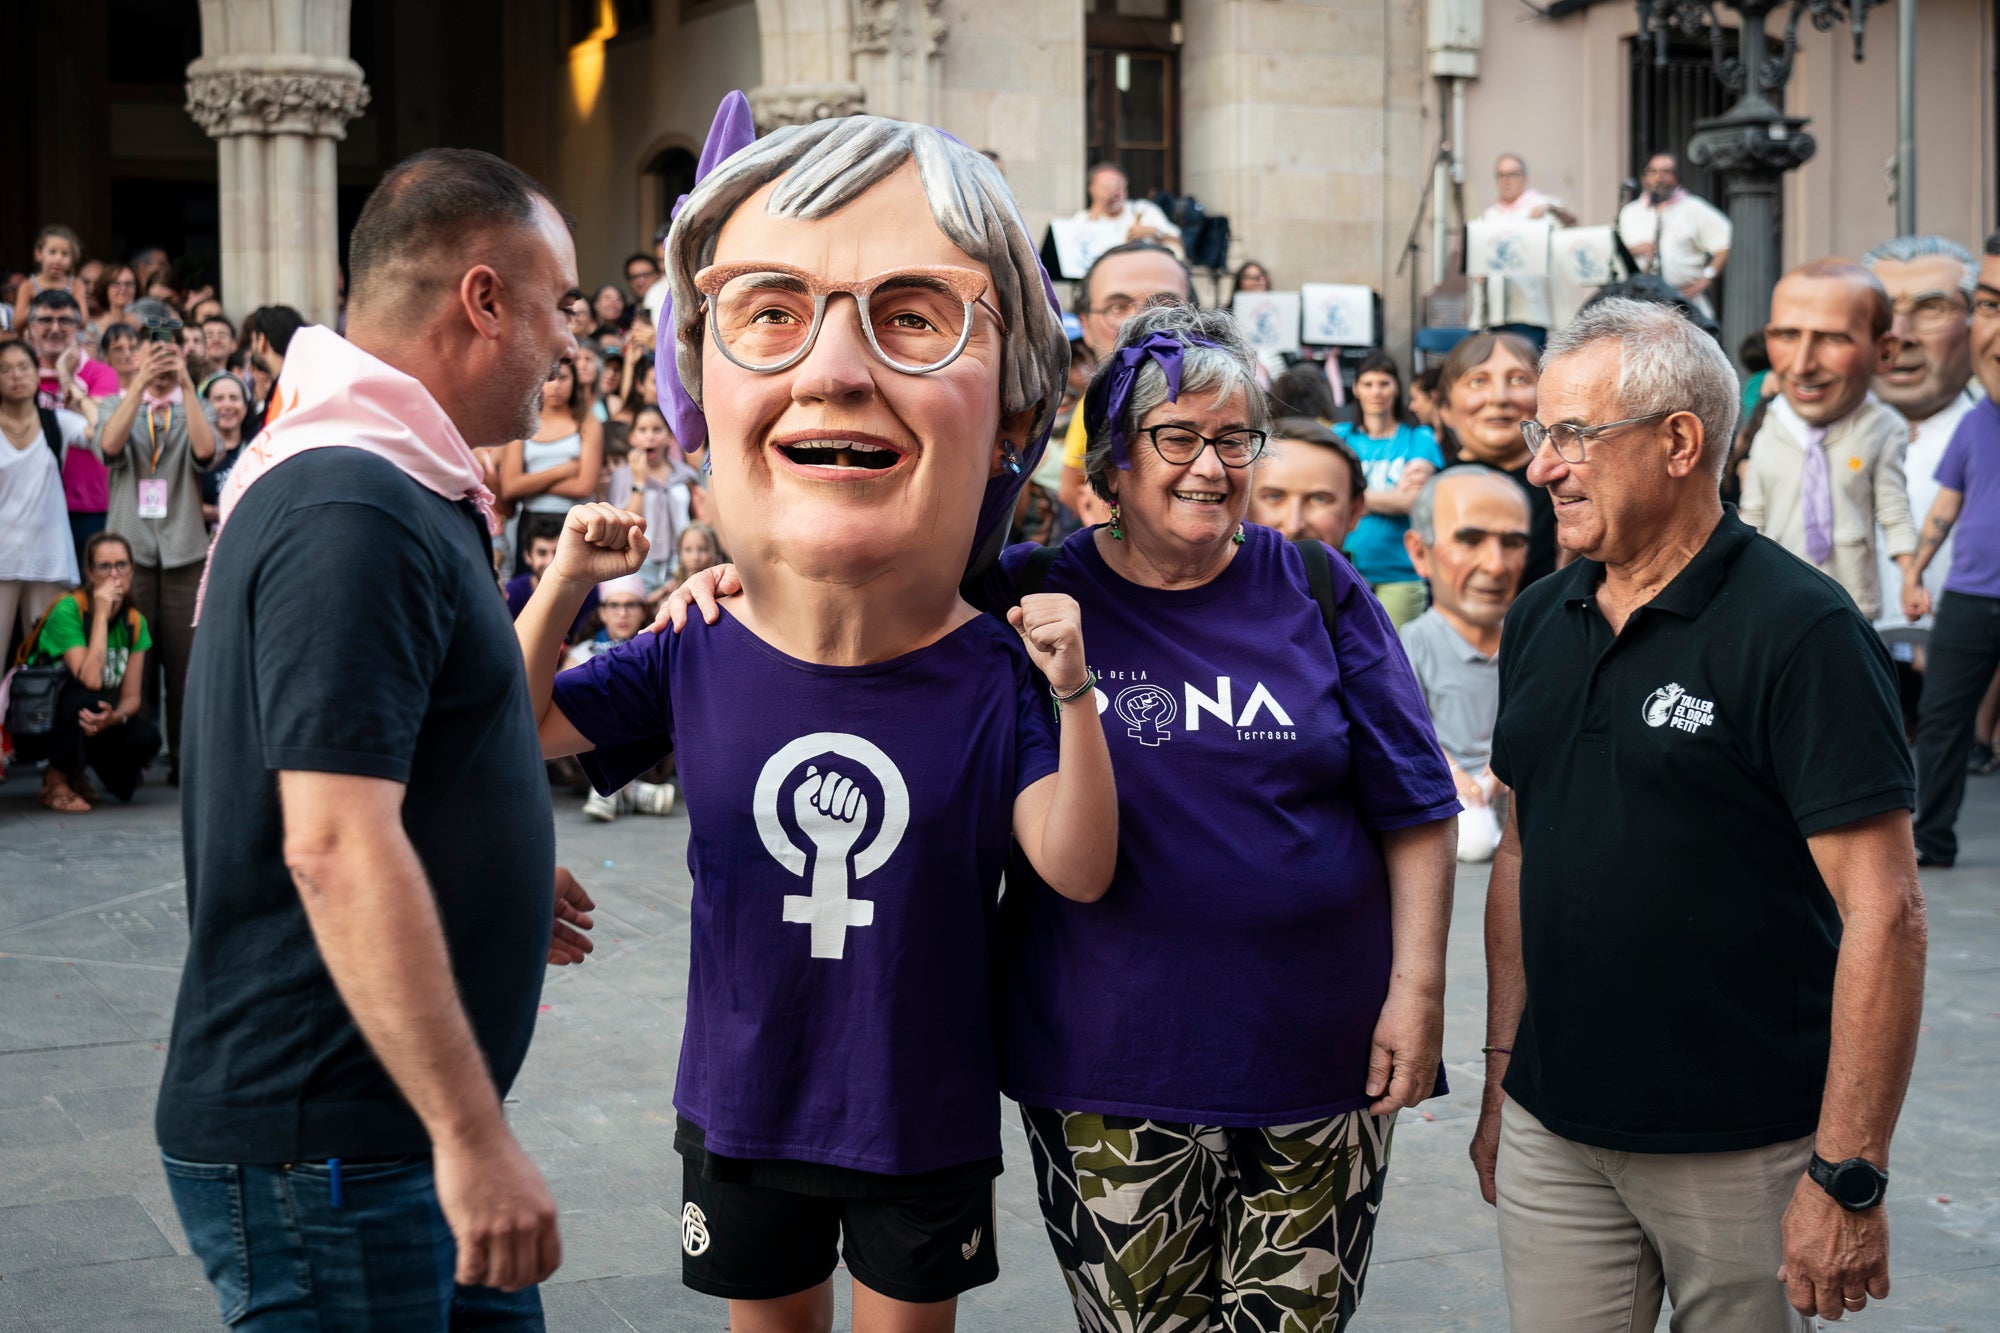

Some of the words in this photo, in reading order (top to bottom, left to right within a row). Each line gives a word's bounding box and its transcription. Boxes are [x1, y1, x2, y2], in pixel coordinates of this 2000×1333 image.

[1110, 670, 1125, 680] DE
[1131, 670, 1147, 681] LA
[1681, 694, 1714, 714] TALLER
[1674, 705, 1686, 718] EL
[1670, 716, 1700, 734] PETIT
[1237, 729, 1297, 741] Terrassa
